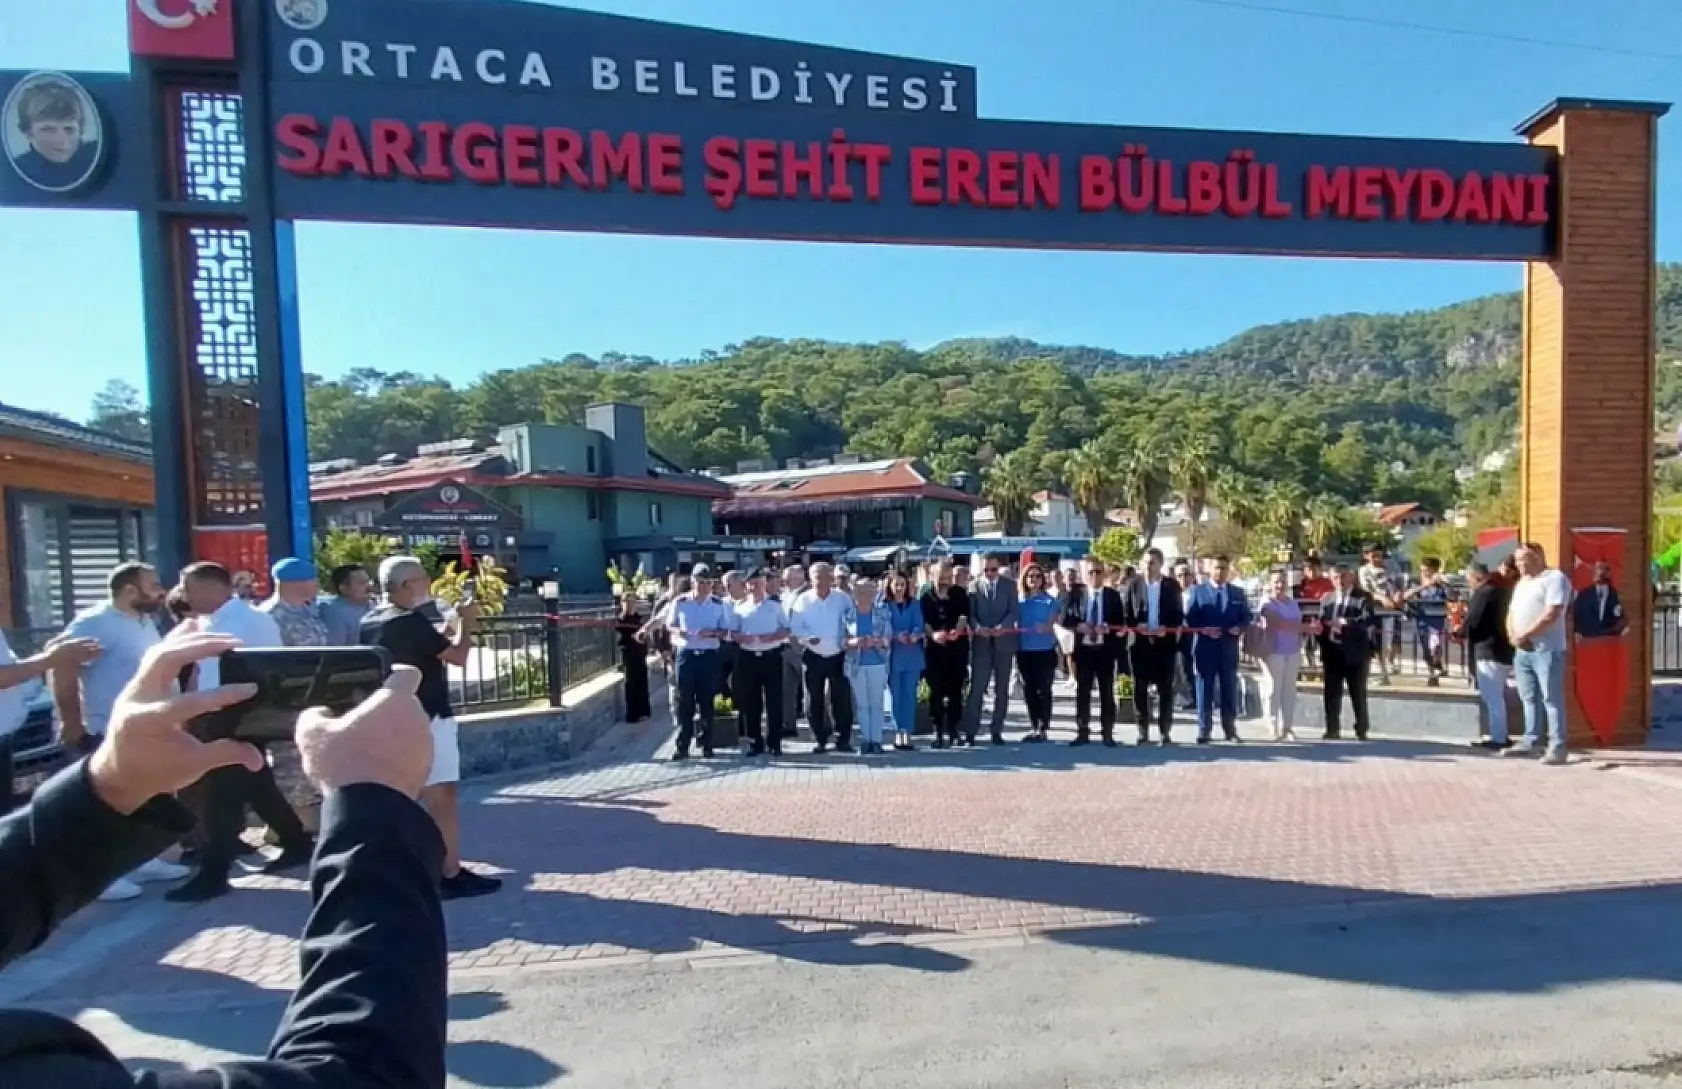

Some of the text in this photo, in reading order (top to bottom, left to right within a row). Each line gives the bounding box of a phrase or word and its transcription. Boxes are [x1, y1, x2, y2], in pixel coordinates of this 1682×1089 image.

[288, 37, 958, 112] ORTACA BELEDİYESİ
[275, 113, 1550, 227] SARIGERME ŞEHİT EREN BÜLBÜL MEYDANI
